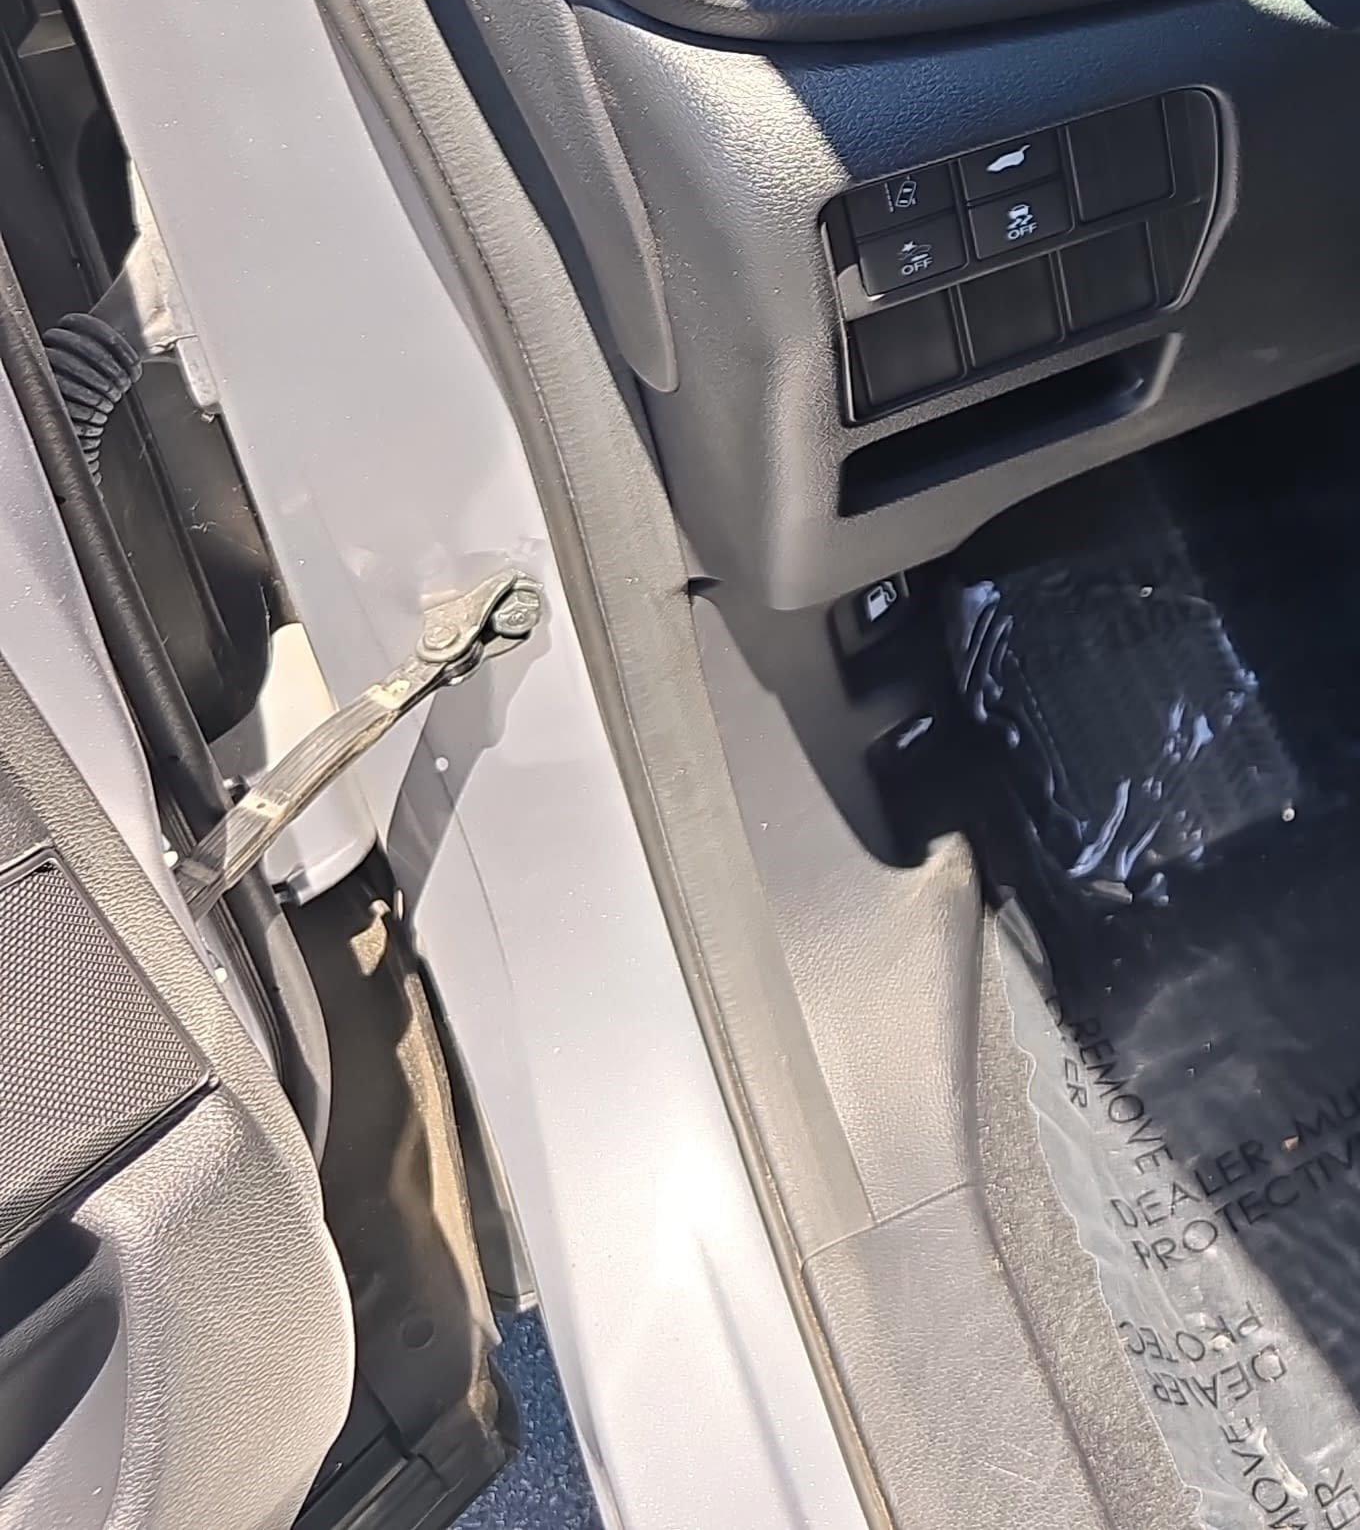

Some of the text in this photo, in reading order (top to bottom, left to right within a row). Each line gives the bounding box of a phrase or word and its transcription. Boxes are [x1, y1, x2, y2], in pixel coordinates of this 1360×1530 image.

[1006, 221, 1039, 241] OFF
[901, 257, 934, 276] OFF
[1068, 1018, 1174, 1176] REMOVE
[1110, 1138, 1271, 1228] DEALER
